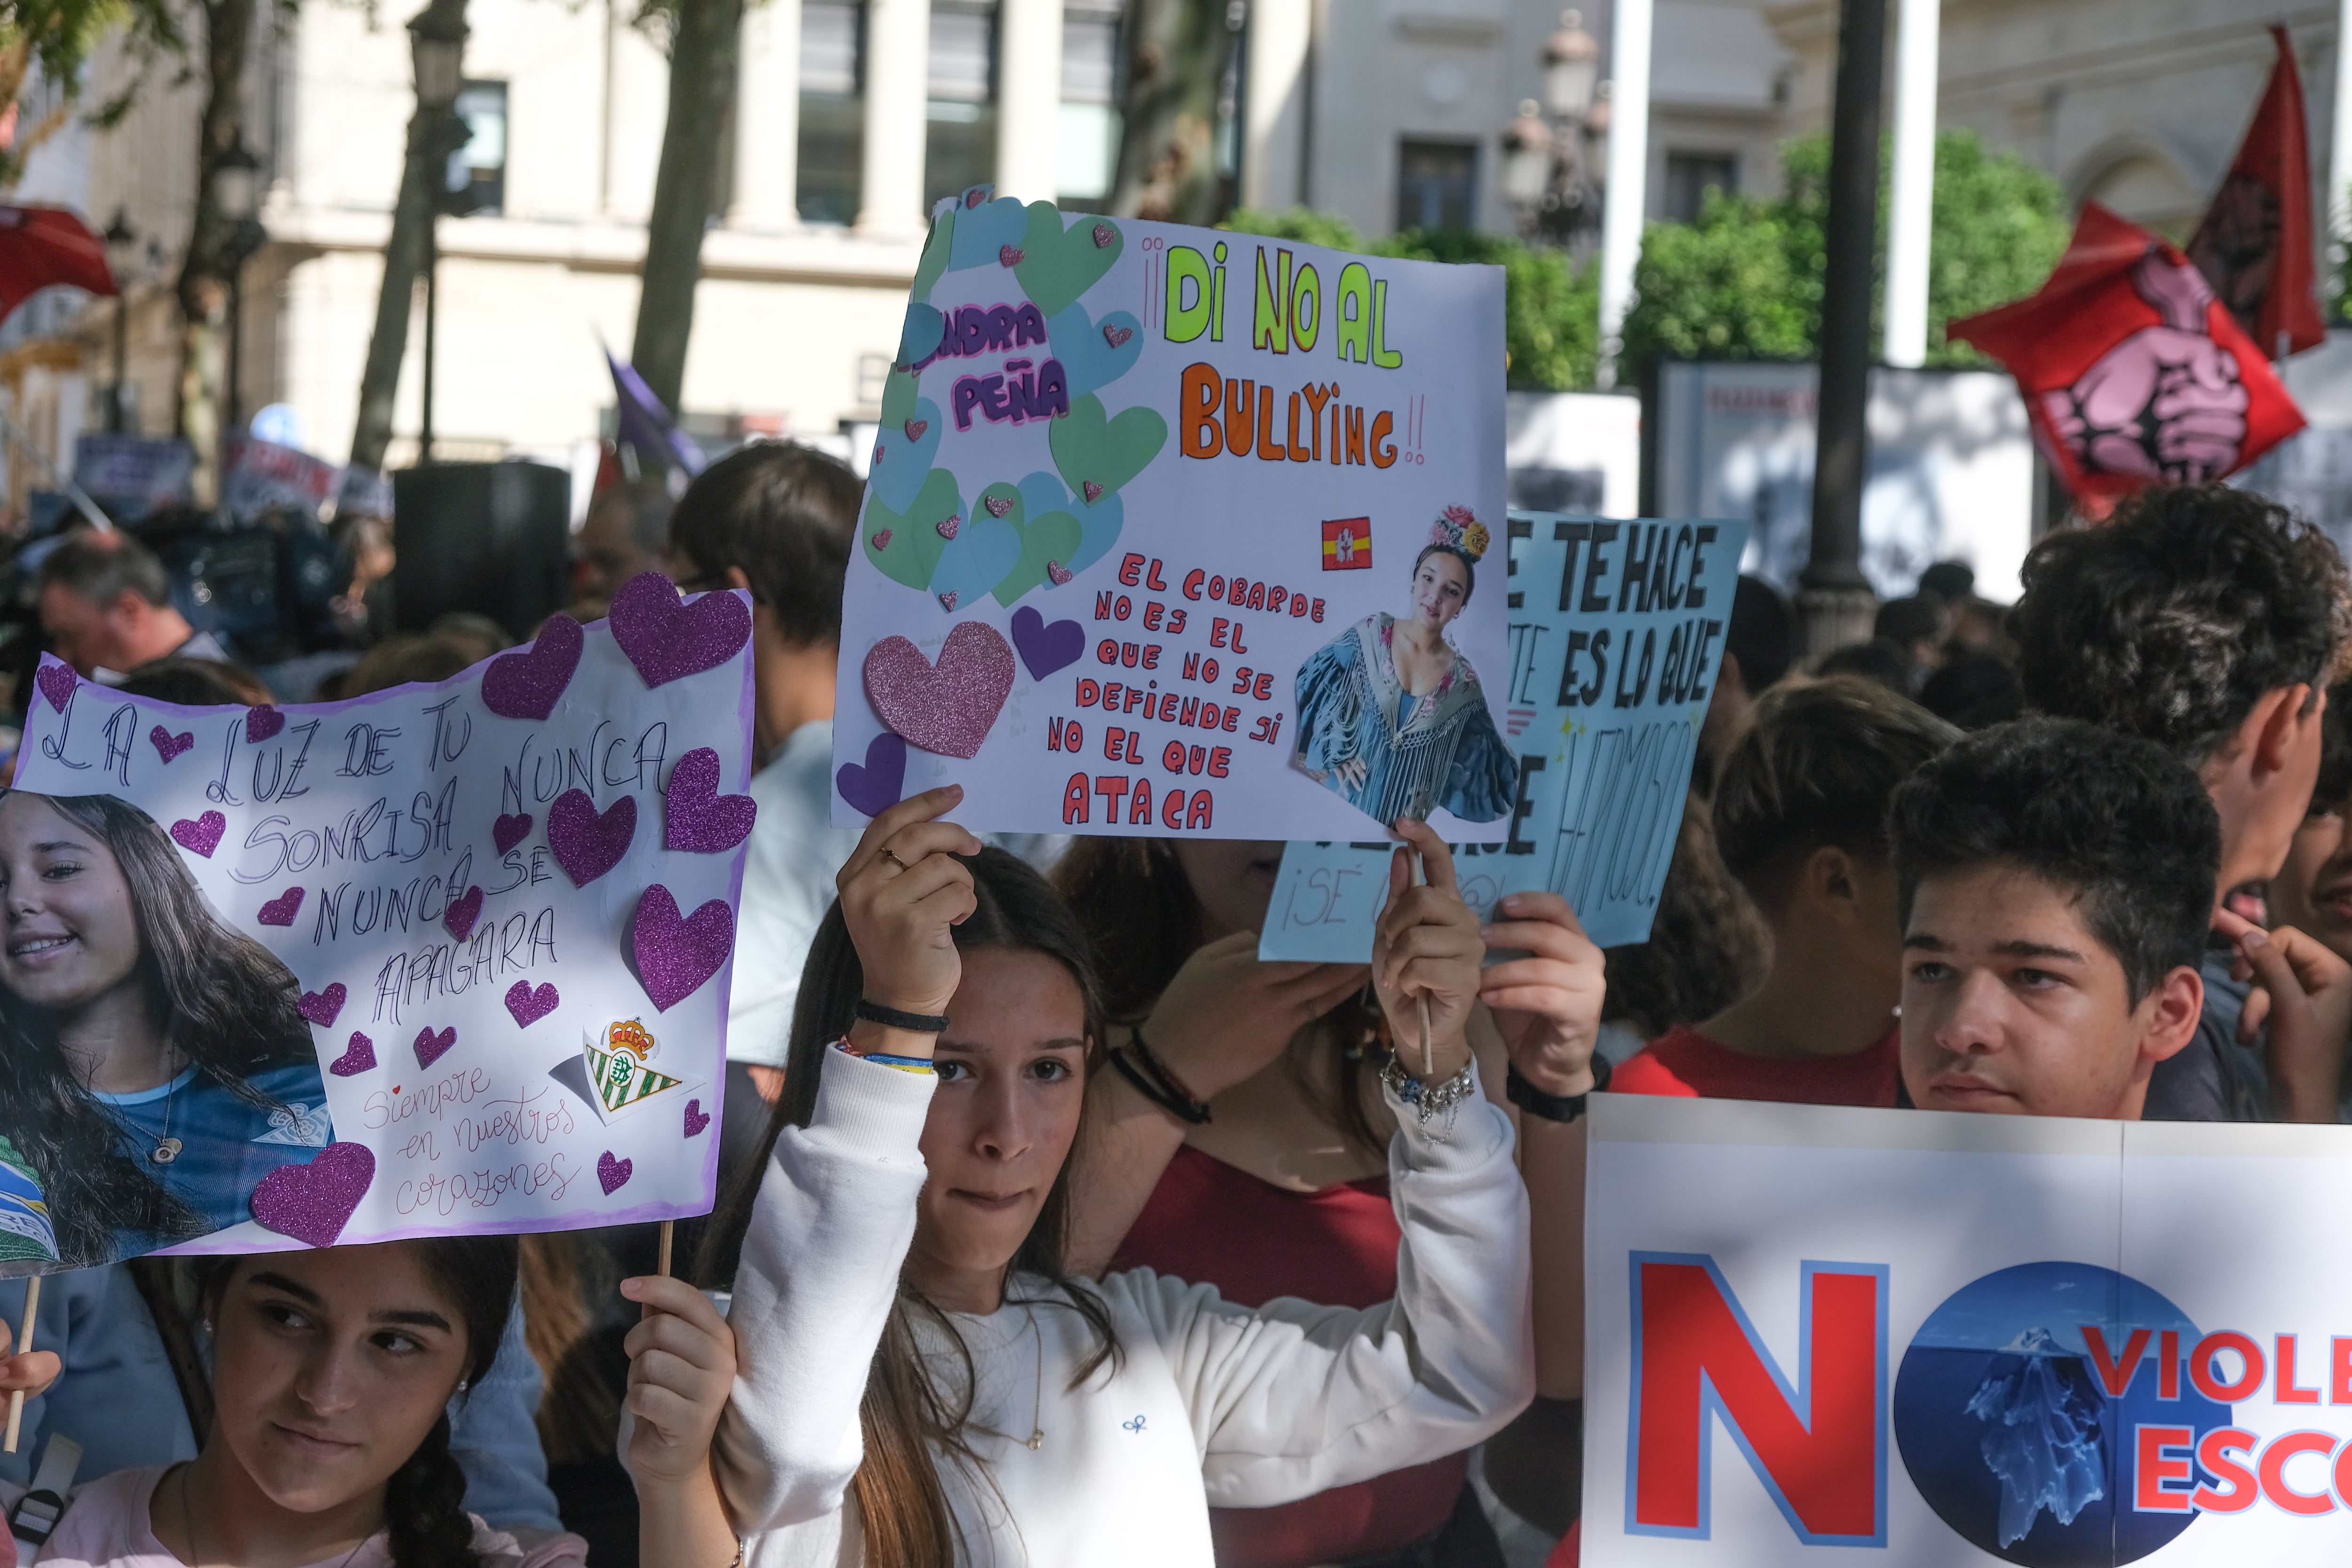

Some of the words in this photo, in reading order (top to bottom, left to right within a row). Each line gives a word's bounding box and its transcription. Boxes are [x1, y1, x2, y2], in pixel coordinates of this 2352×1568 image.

[1253, 244, 1321, 355] NO
[1337, 261, 1403, 369] AL
[950, 357, 1070, 432] PEÑA
[1118, 552, 1167, 591] EL
[1182, 568, 1326, 623] COBARDE
[1554, 519, 1621, 613] TE
[1617, 523, 1719, 613] HACE
[1094, 590, 1132, 621] NO
[1143, 601, 1187, 634] ES
[1209, 617, 1248, 654] EL
[1097, 638, 1162, 669] QUE
[1182, 651, 1219, 684] NO
[1232, 667, 1274, 700] SE
[1557, 627, 1612, 708] ES
[1613, 626, 1657, 708] LO
[1658, 617, 1724, 706] QUE
[42, 683, 139, 787] LA
[206, 718, 320, 806] LUZ
[335, 722, 402, 778] DE
[422, 694, 471, 772] TU
[1048, 716, 1083, 754] NO
[1104, 726, 1144, 764] EL
[1162, 740, 1232, 778] QUE
[227, 775, 458, 884] SONRISA
[501, 720, 668, 814] NUNCA
[1062, 772, 1214, 829] ATACA
[313, 845, 472, 947] NUNCA
[486, 845, 553, 896] SE
[372, 906, 557, 1025] APAGARA
[363, 1067, 491, 1129] Siempre
[397, 1131, 440, 1161] en
[454, 1086, 575, 1153] nuestros
[396, 1153, 583, 1216] corazones
[2132, 1423, 2352, 1518] ESC
